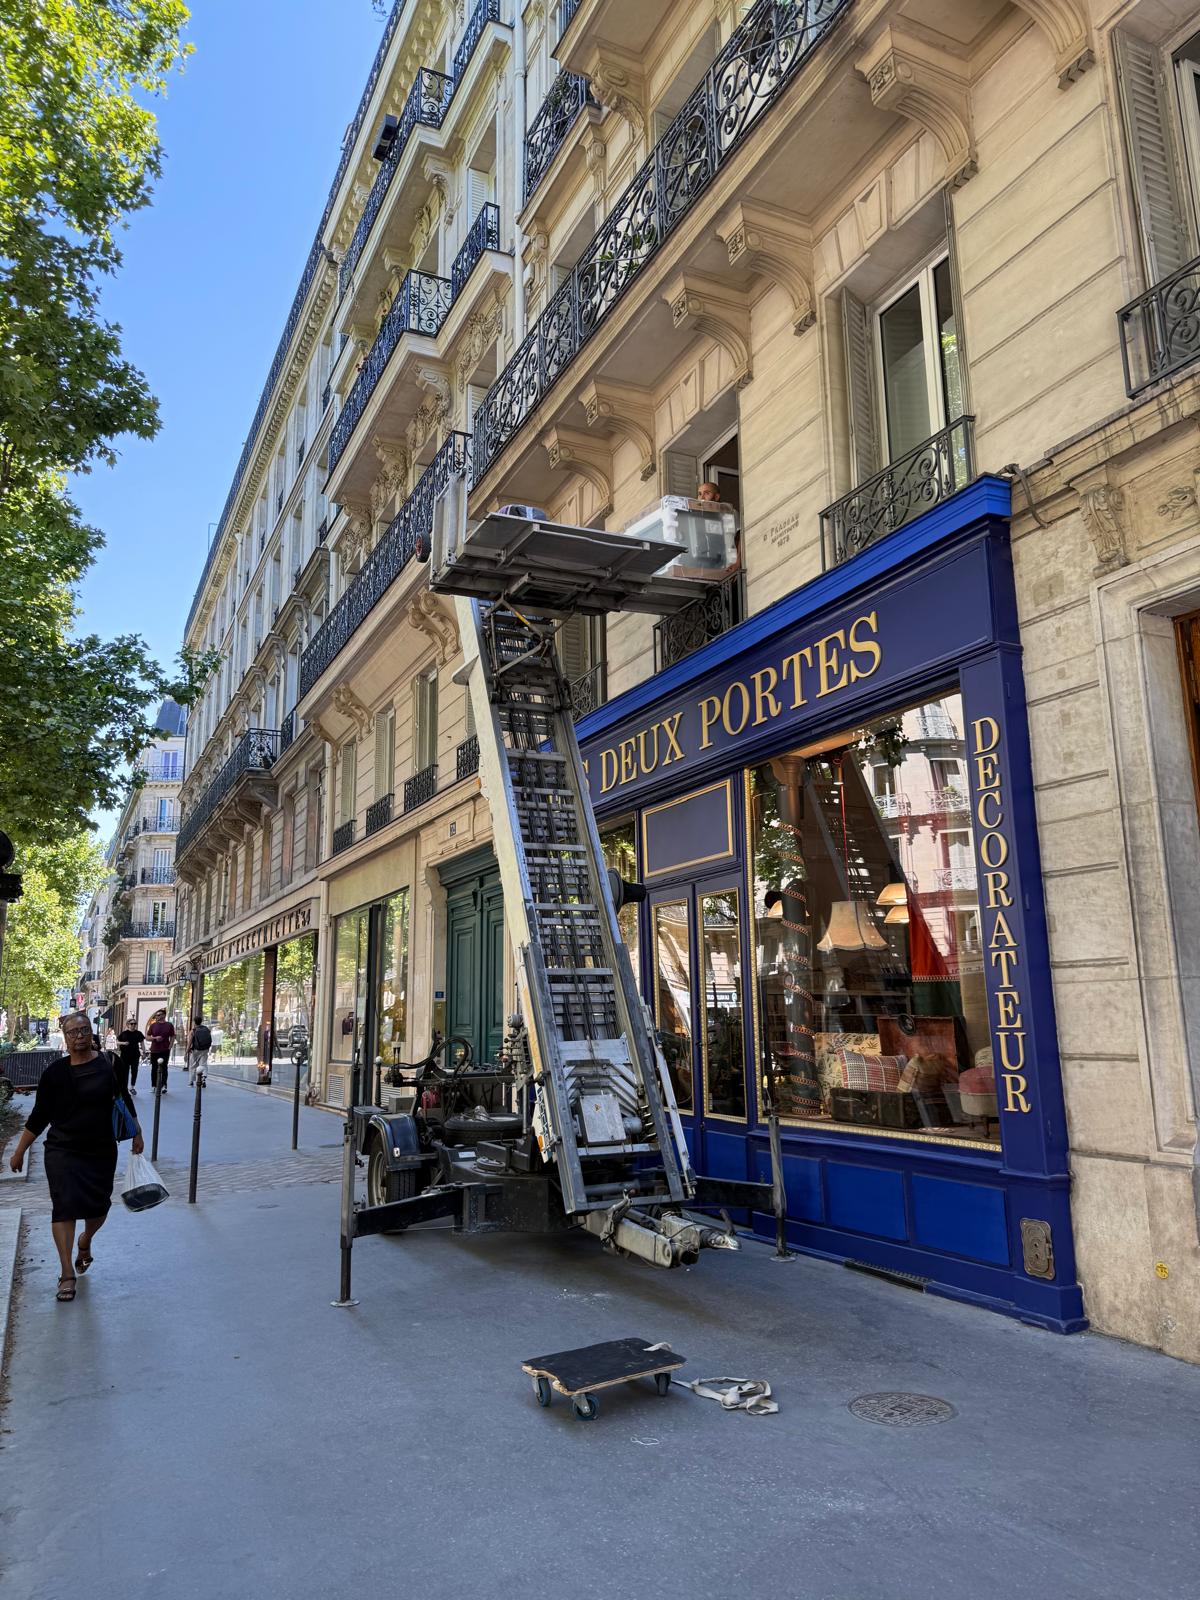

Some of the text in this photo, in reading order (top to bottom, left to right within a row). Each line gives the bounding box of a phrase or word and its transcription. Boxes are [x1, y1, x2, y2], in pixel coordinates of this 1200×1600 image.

[599, 611, 884, 793] DEUX PORTES
[971, 716, 1031, 1113] DECORATEUR
